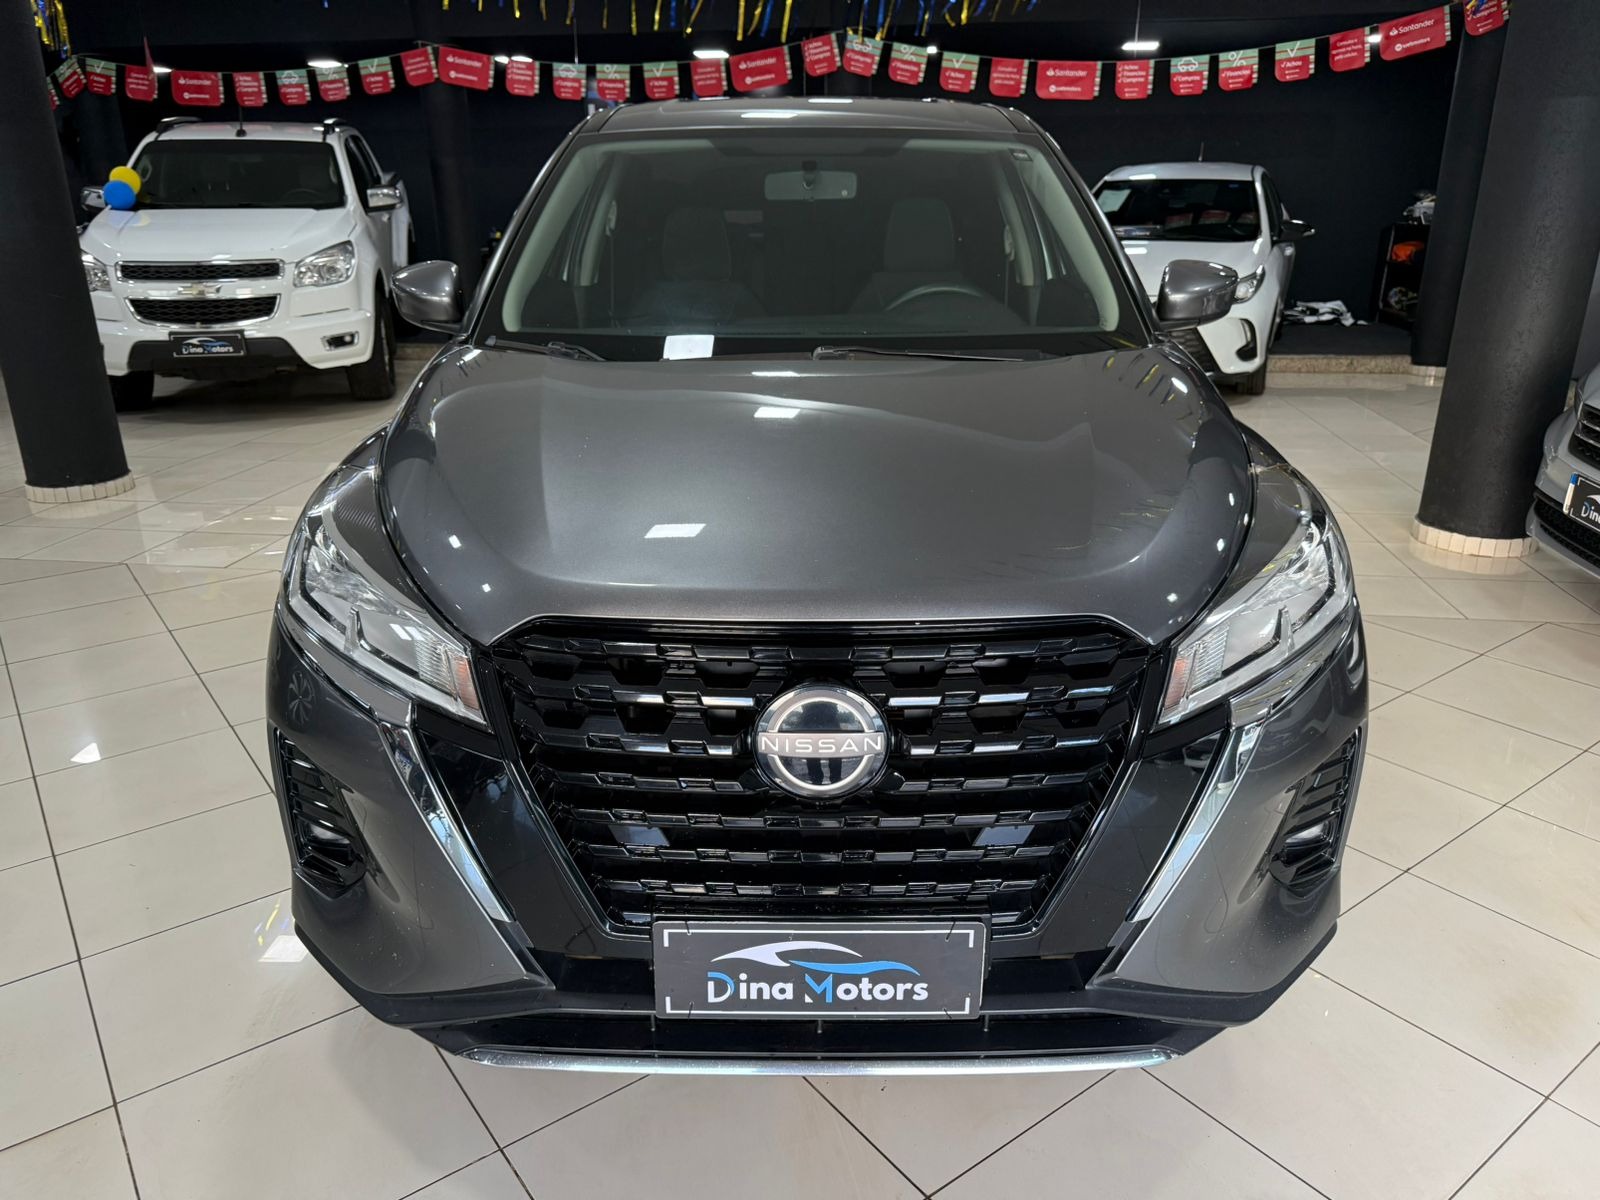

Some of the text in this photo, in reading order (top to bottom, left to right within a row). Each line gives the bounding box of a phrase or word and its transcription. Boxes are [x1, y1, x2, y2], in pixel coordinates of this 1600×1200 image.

[1398, 19, 1434, 34] Santander
[746, 56, 776, 69] Santander
[1055, 69, 1088, 77] Santander
[761, 736, 881, 753] NISSAN
[707, 972, 929, 1003] Dina Motors
